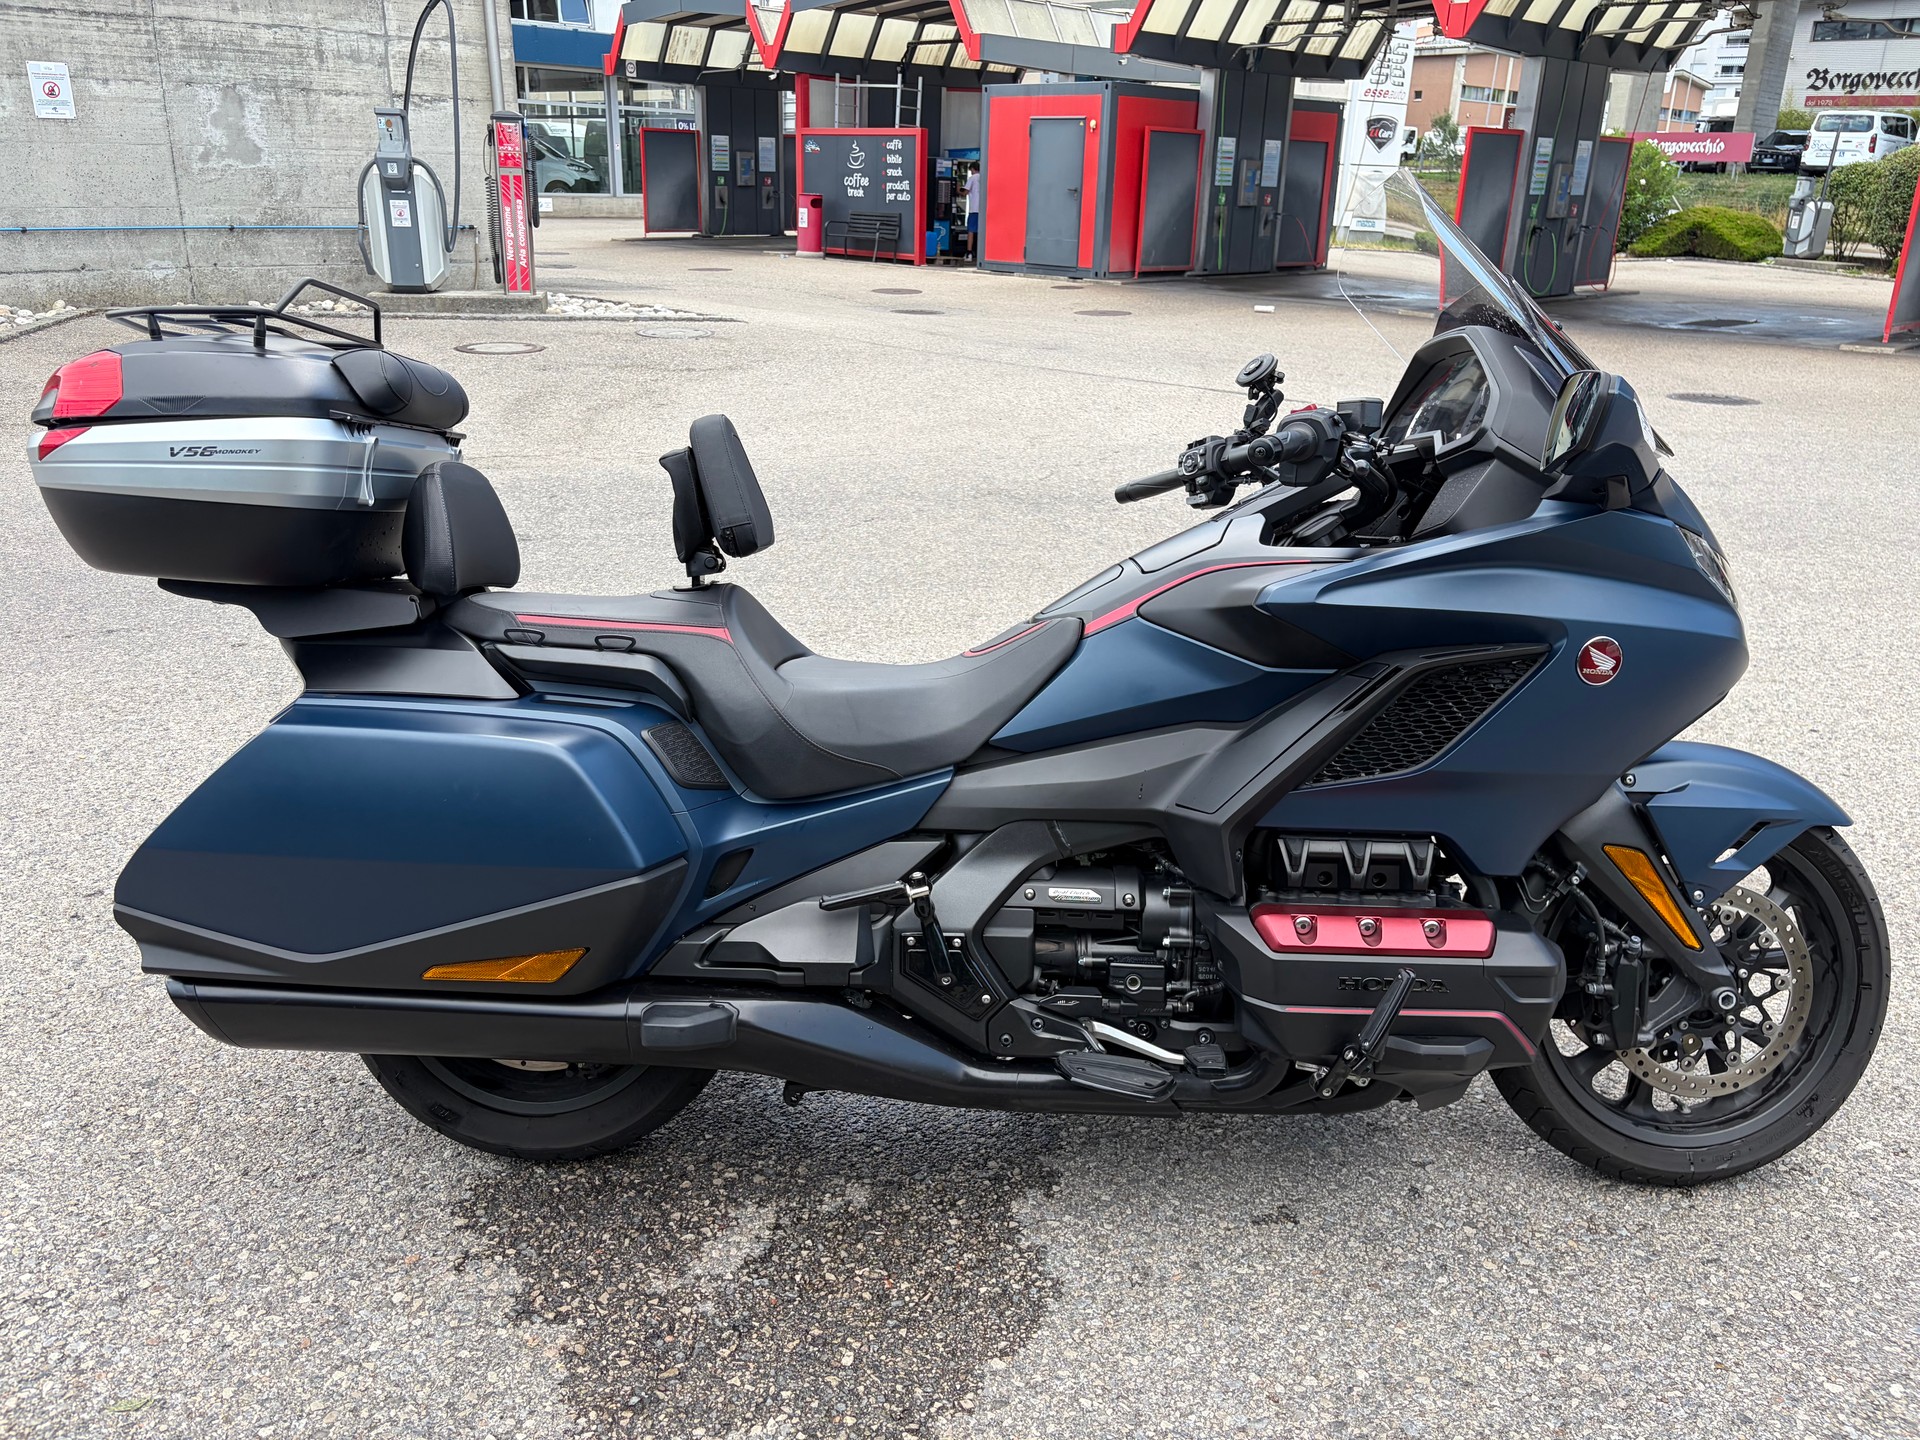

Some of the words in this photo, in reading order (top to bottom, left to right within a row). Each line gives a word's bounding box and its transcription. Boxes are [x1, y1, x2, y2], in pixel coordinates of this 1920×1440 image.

[886, 139, 903, 151] caffè
[886, 154, 903, 164] bibite
[886, 167, 903, 177] snack
[843, 173, 870, 188] coffee
[886, 180, 910, 192] prodotti
[847, 187, 865, 197] break
[886, 193, 896, 203] per
[896, 192, 911, 201] auto
[504, 206, 514, 238] gomme
[516, 198, 527, 246] compressa
[506, 240, 514, 261] Nero
[169, 446, 218, 458] V56
[1582, 668, 1614, 676] HONDA
